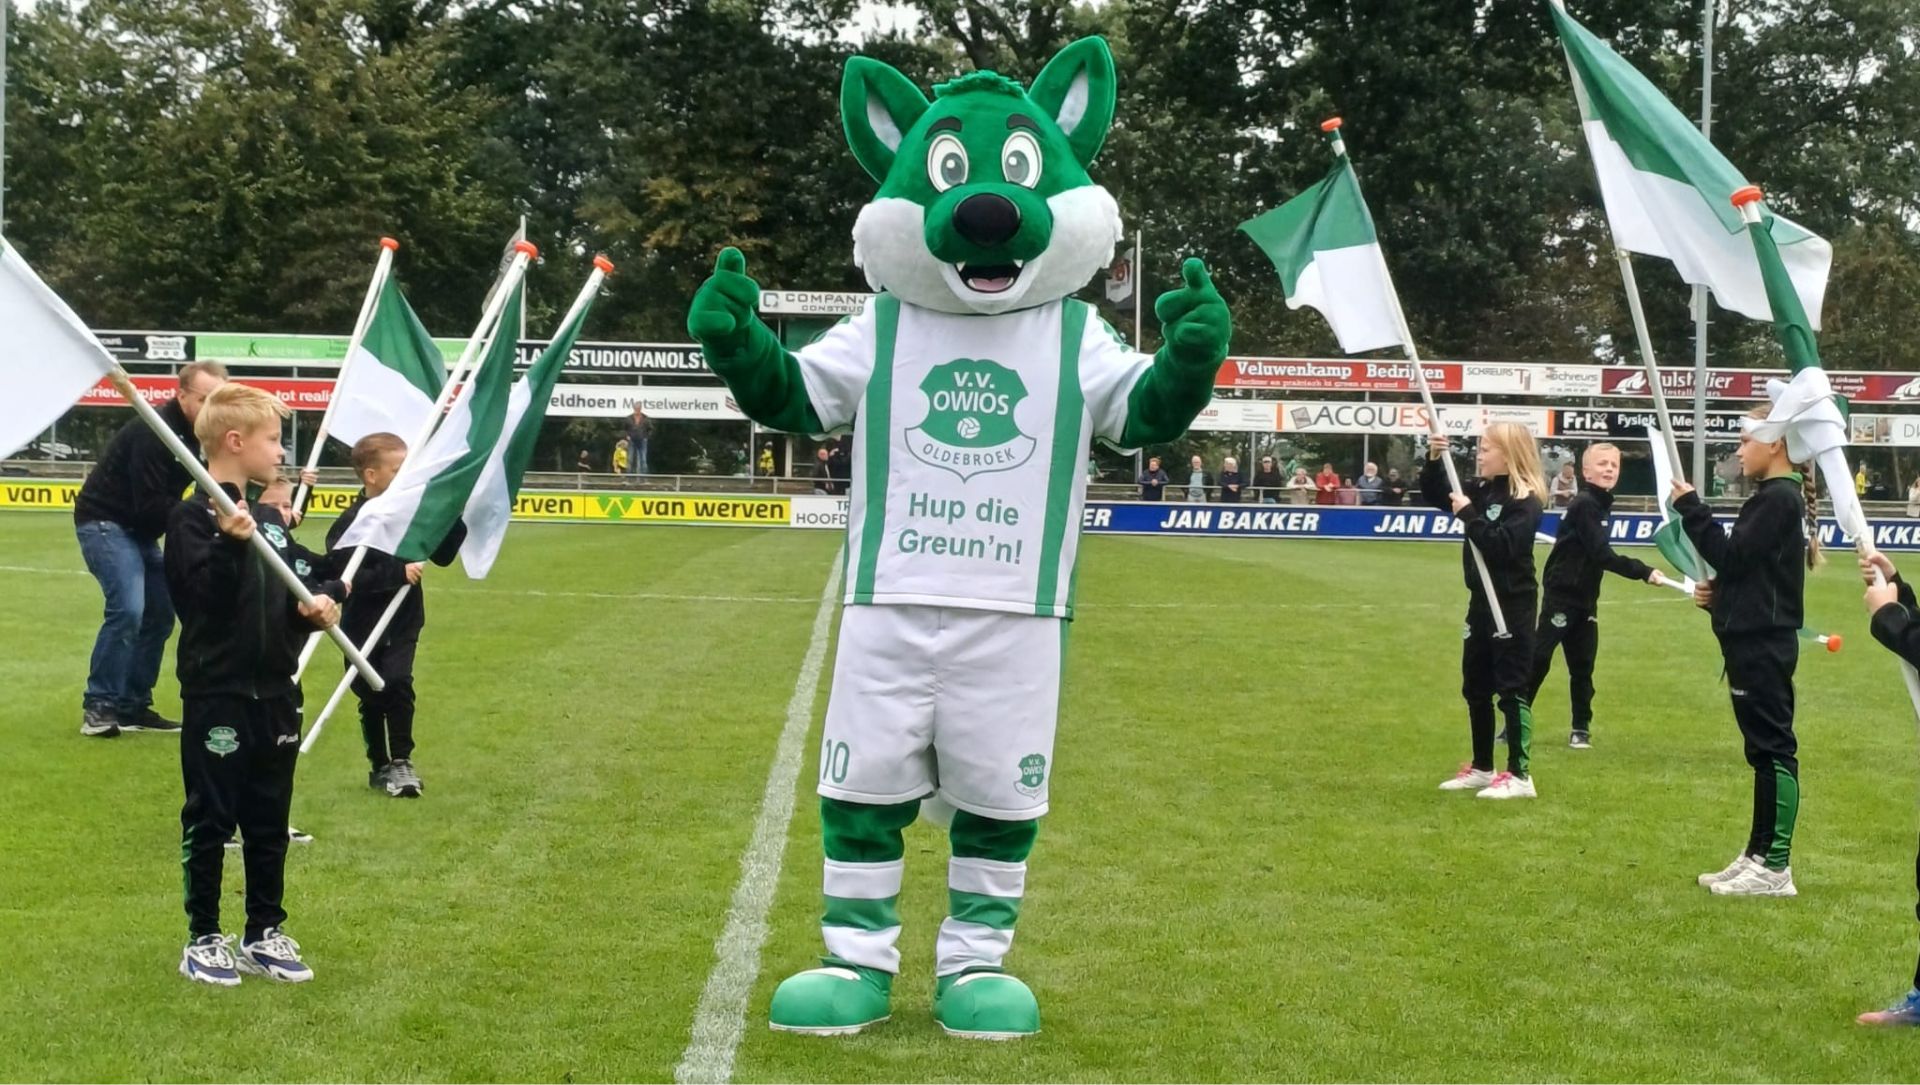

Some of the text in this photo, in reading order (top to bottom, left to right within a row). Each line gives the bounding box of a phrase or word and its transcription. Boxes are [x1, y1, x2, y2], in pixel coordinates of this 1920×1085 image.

[785, 293, 868, 304] COMPANJ
[801, 304, 864, 313] CONSTRUC
[1235, 361, 1352, 380] Veluwenkamp
[1648, 371, 1734, 389] ulstlier
[275, 389, 296, 402] tot
[1663, 388, 1722, 397] Installurs
[550, 393, 719, 412] eldhoen Mtselwerken
[933, 390, 1009, 416] OWIOS
[1312, 405, 1447, 430] ACQUEST
[1617, 413, 1657, 427] Fysiek
[1672, 415, 1725, 428] Mesch
[922, 442, 1016, 466] OLDEBROEK
[7, 487, 52, 503] van
[310, 491, 358, 509] rve
[511, 497, 573, 514] erven
[641, 501, 785, 519] van werven
[908, 492, 1020, 526] Hup die
[1160, 509, 1320, 532] JAN BAKKER
[1373, 514, 1426, 534] JAN
[898, 528, 1023, 565] Greun’n!
[823, 738, 849, 784] 10
